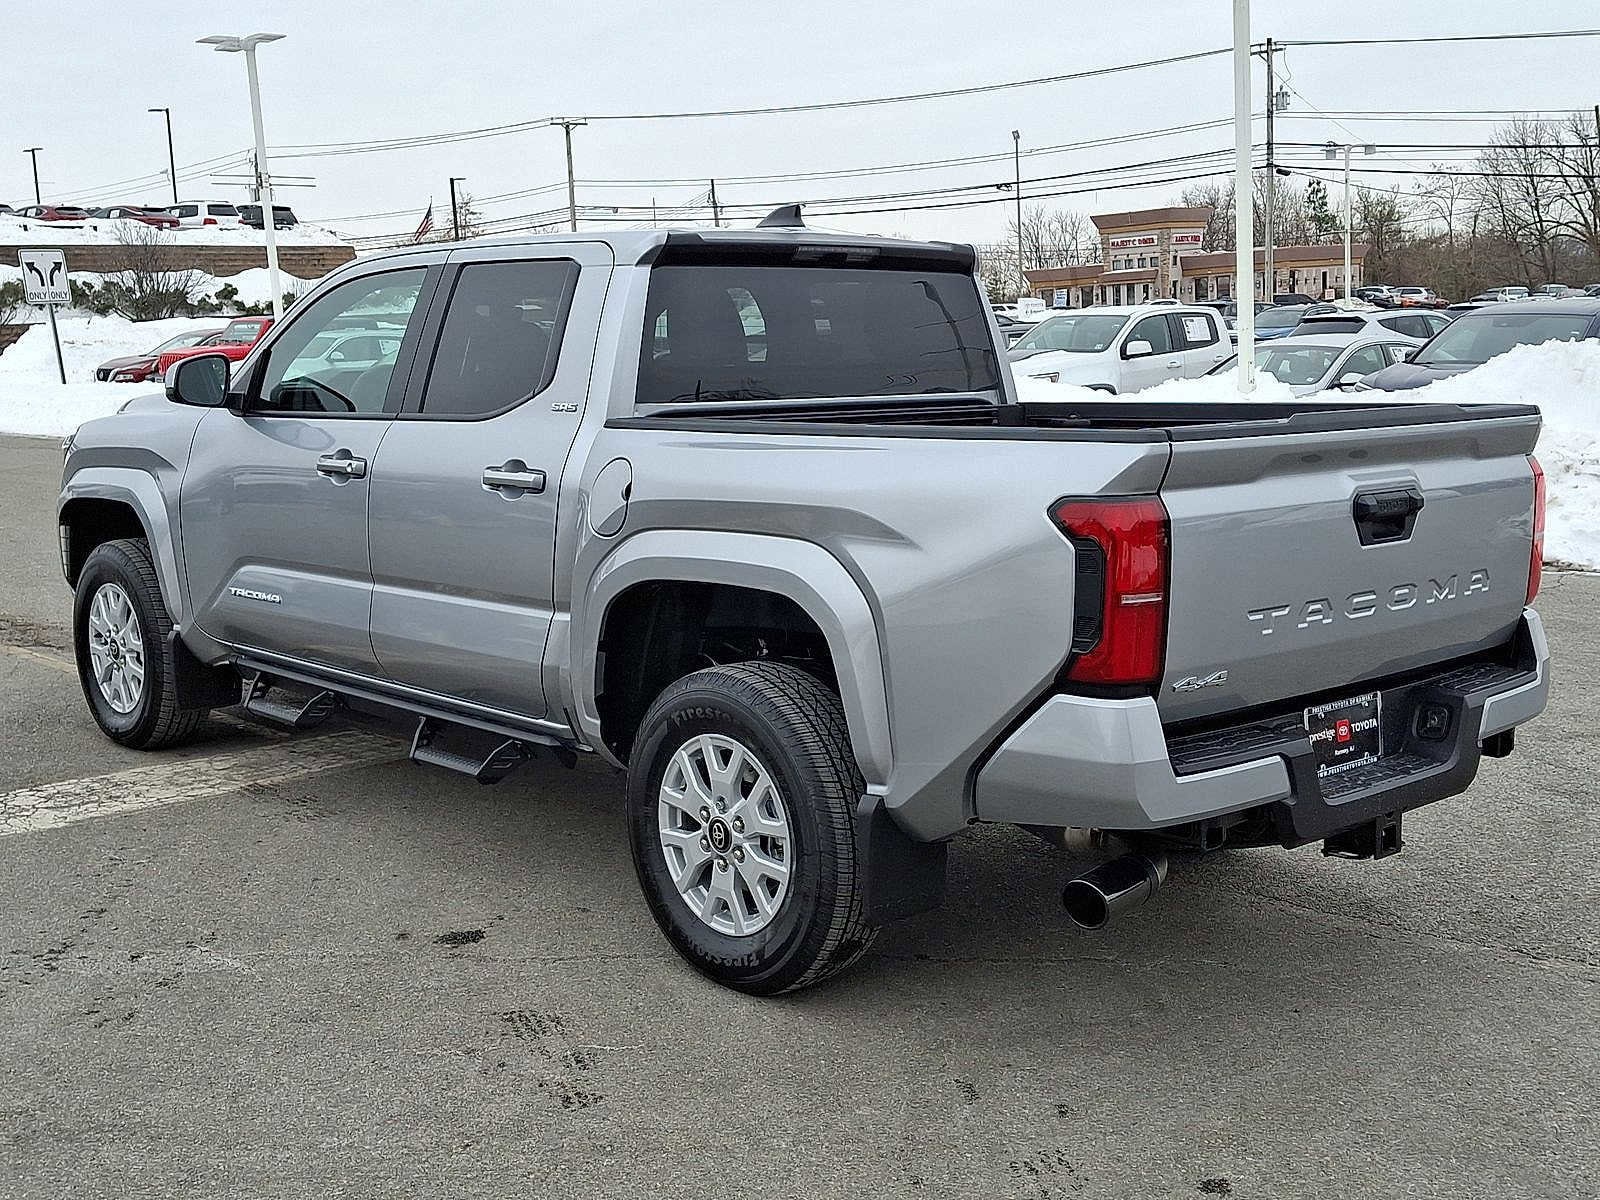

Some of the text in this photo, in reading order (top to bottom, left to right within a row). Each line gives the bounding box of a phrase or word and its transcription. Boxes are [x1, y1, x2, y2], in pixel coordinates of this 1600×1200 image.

[1111, 239, 1137, 247] MAJESTC
[29, 291, 68, 300] ONLY ONLY
[228, 586, 281, 604] TACOMA
[1247, 568, 1490, 635] TACOMA
[671, 706, 742, 728] Firesto
[1309, 718, 1377, 746] prestige TOYOTA
